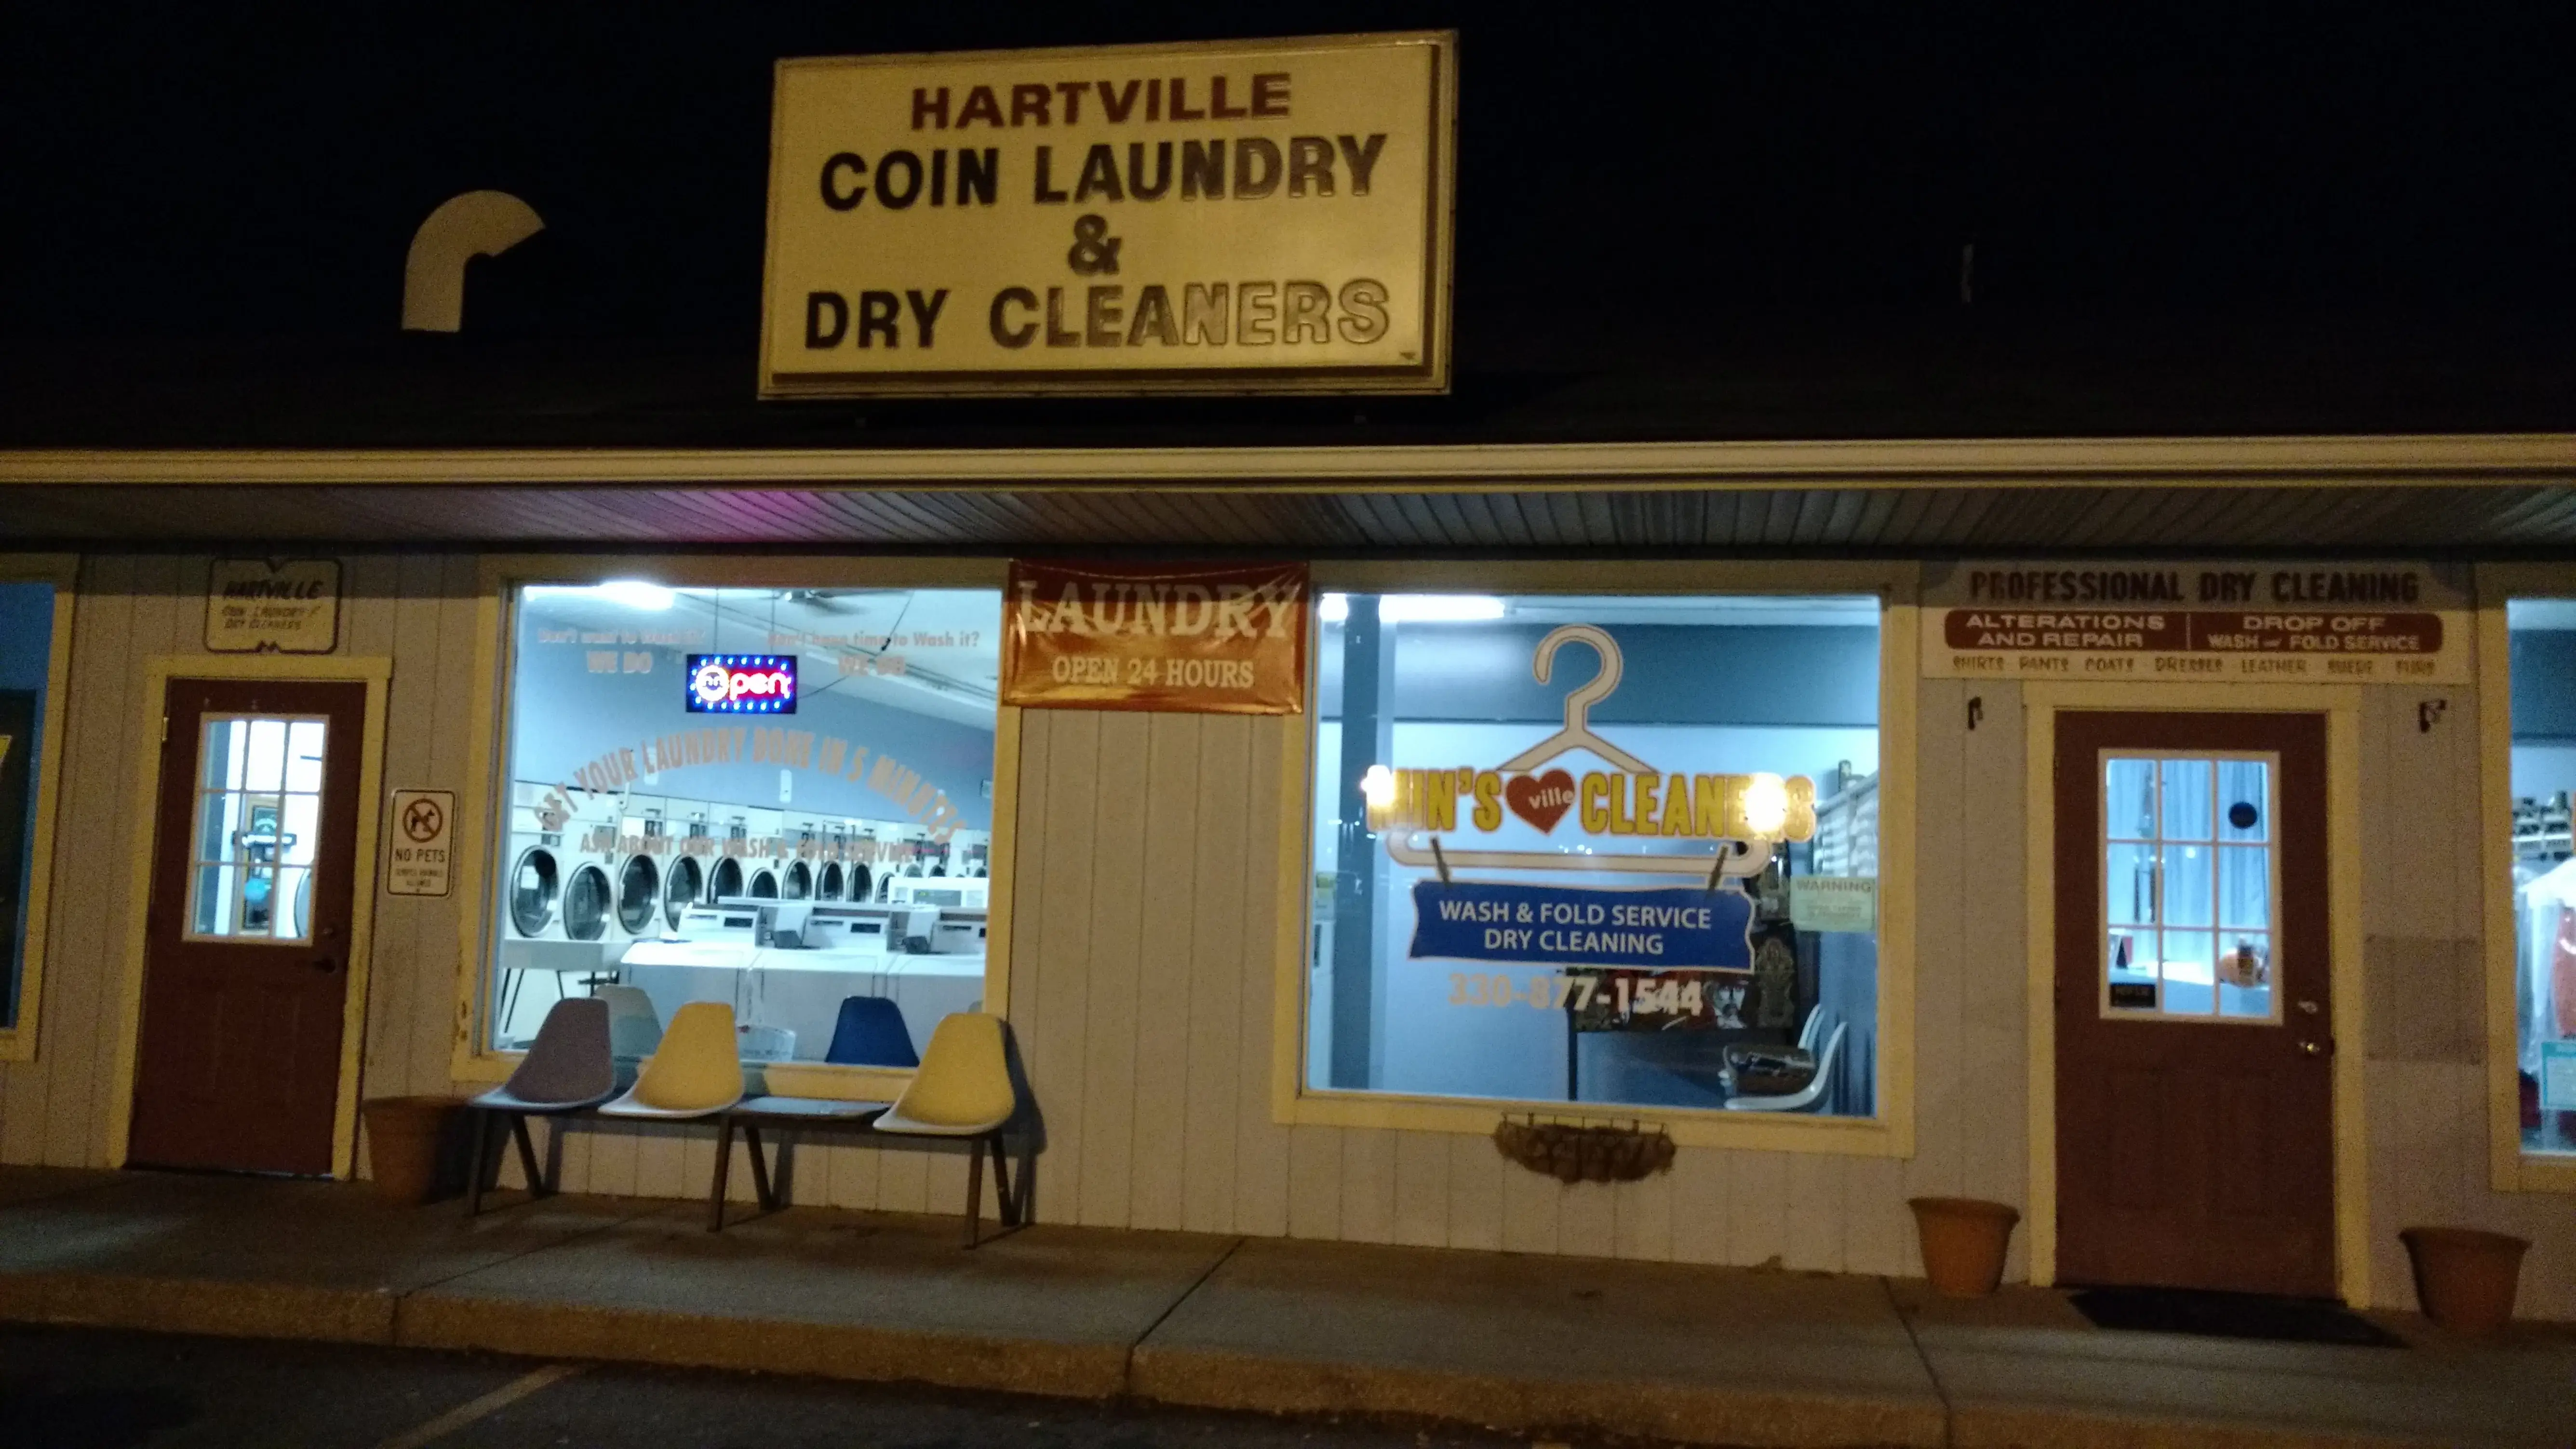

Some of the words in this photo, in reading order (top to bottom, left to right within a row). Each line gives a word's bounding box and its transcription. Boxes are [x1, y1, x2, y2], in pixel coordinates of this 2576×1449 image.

[911, 73, 1290, 130] HARTVILLE
[820, 147, 998, 212] COIN
[1034, 133, 1387, 205] LAUNDRY
[1067, 214, 1122, 275] &
[805, 290, 948, 349] DRY
[989, 278, 1390, 349] CLEANERS
[1971, 572, 2185, 601] PROFESSIONAL
[2200, 572, 2257, 602] DRY
[2272, 572, 2418, 602] CLEANING
[1019, 581, 1300, 638] LAUNDRY
[1965, 614, 2165, 631] ALTERATIONS
[2243, 615, 2324, 631] DROP
[2330, 616, 2387, 632] OFF
[894, 632, 908, 646] to
[913, 631, 954, 646] Wash
[960, 631, 980, 647] it?
[1977, 632, 2037, 646] AND
[2042, 632, 2143, 647] REPAIR
[2207, 634, 2259, 650] WASH
[2289, 634, 2339, 650] FOLD
[2345, 635, 2420, 651] SERVICE
[1052, 656, 1119, 684] OPEN
[1127, 657, 1157, 685] 24
[1166, 658, 1254, 688] HOURS
[573, 747, 638, 800] YOUR
[641, 727, 746, 774] LAUNDRY
[752, 727, 815, 768] DONE
[819, 736, 847, 775] IN
[868, 755, 966, 845] MINUTES
[1529, 787, 1574, 810] ville
[1581, 771, 1816, 842] CLEANES
[395, 848, 410, 862] NO
[417, 848, 445, 863] PETS
[619, 835, 673, 856] ABOUT
[724, 837, 770, 859] WASH
[1797, 879, 1871, 893] WARNING
[1439, 900, 1509, 923] WASH
[1516, 903, 1533, 923] &
[1541, 903, 1605, 926] FOLD
[1612, 905, 1712, 929] SERVICE
[1485, 928, 1533, 950] DRY
[1539, 931, 1664, 955] CLEANING
[1449, 973, 1704, 1016] 330-877-1544
